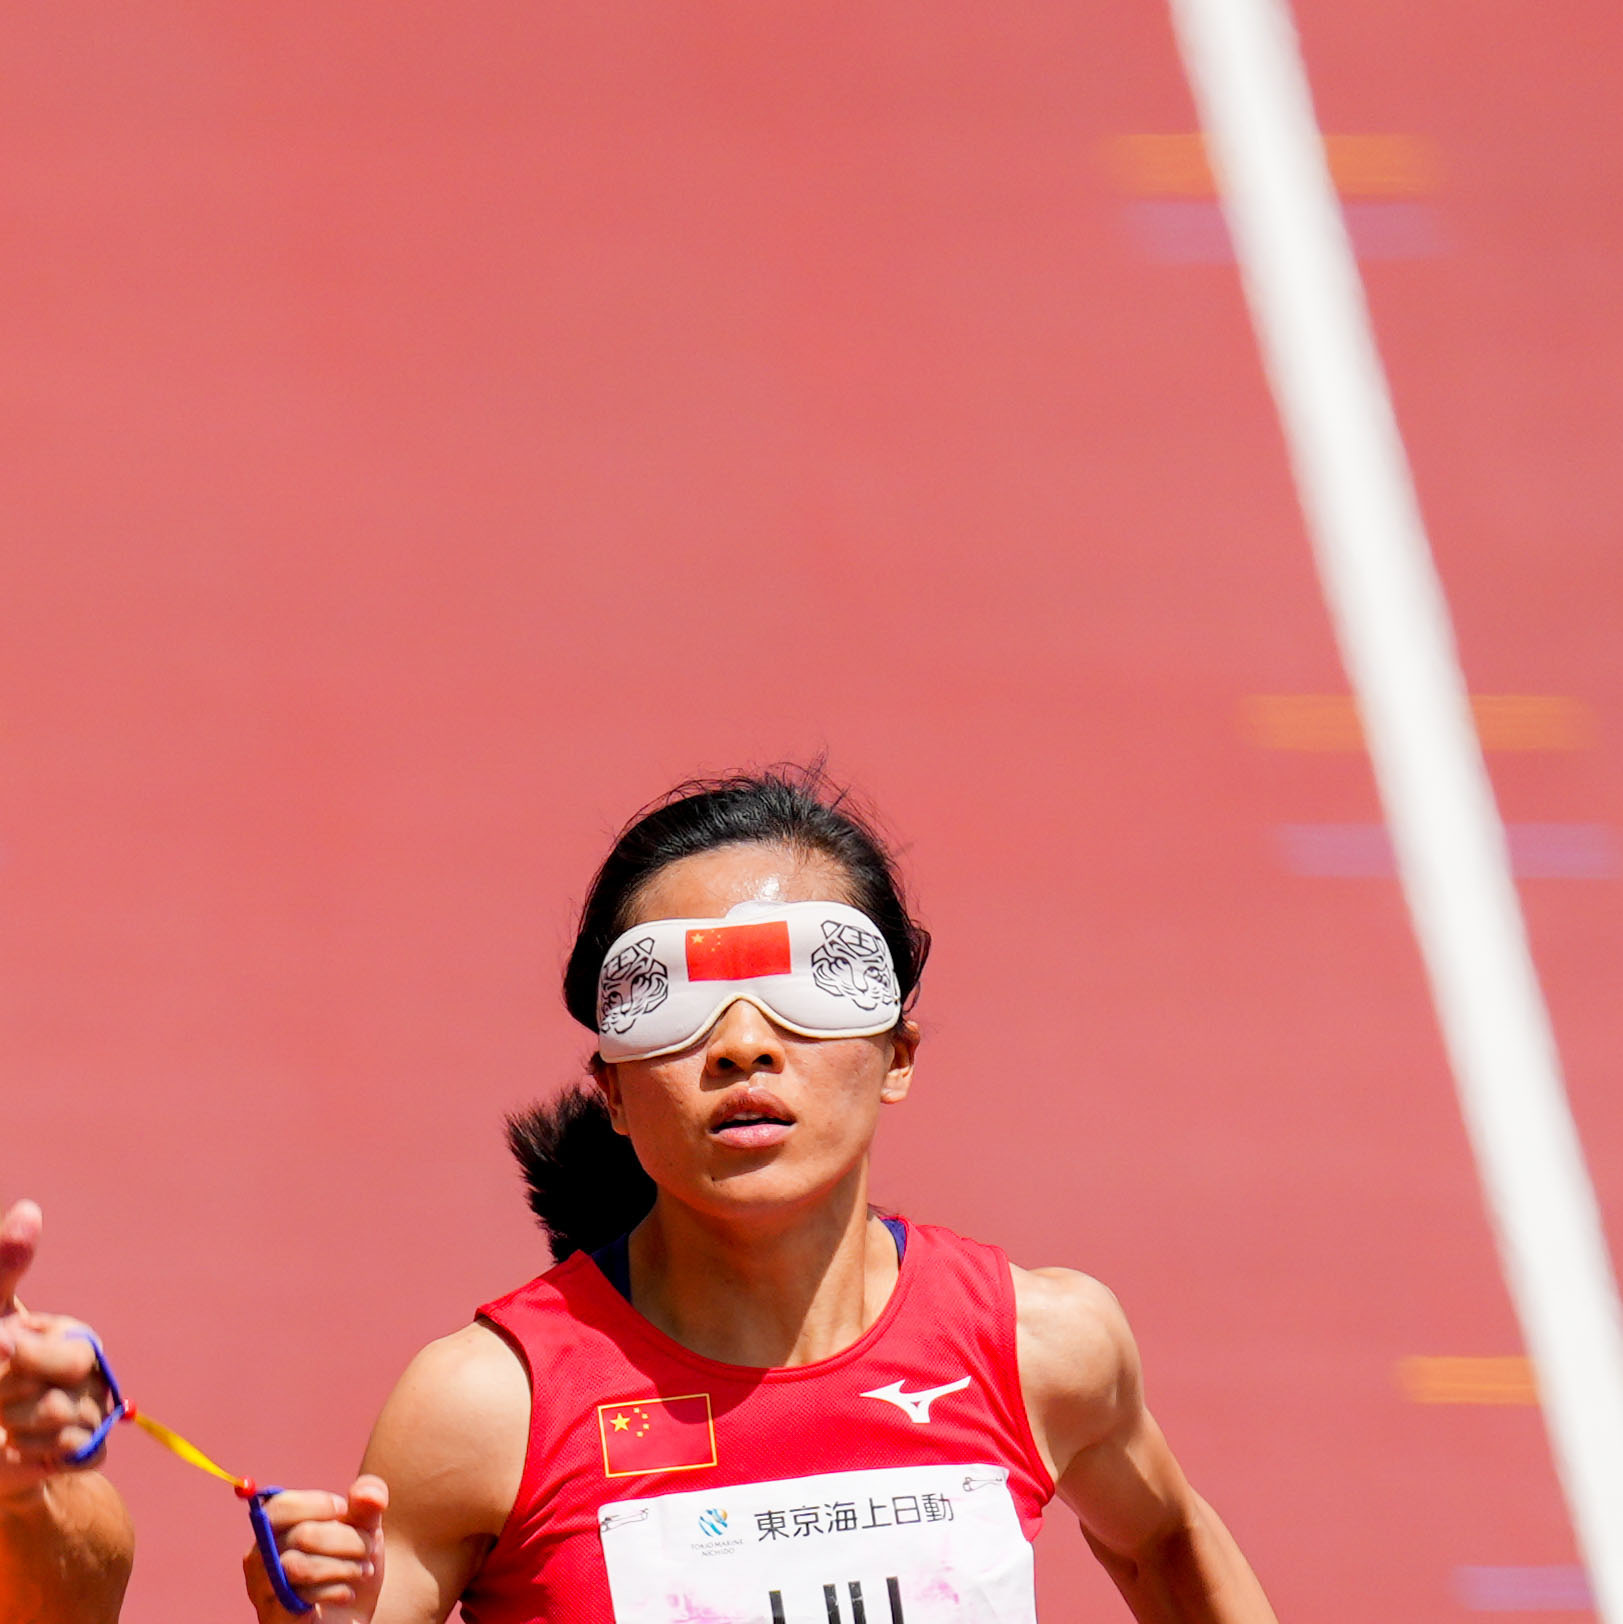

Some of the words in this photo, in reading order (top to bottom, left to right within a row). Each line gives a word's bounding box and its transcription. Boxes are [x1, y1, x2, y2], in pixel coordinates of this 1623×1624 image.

[753, 1492, 955, 1542] 東京海上日動
